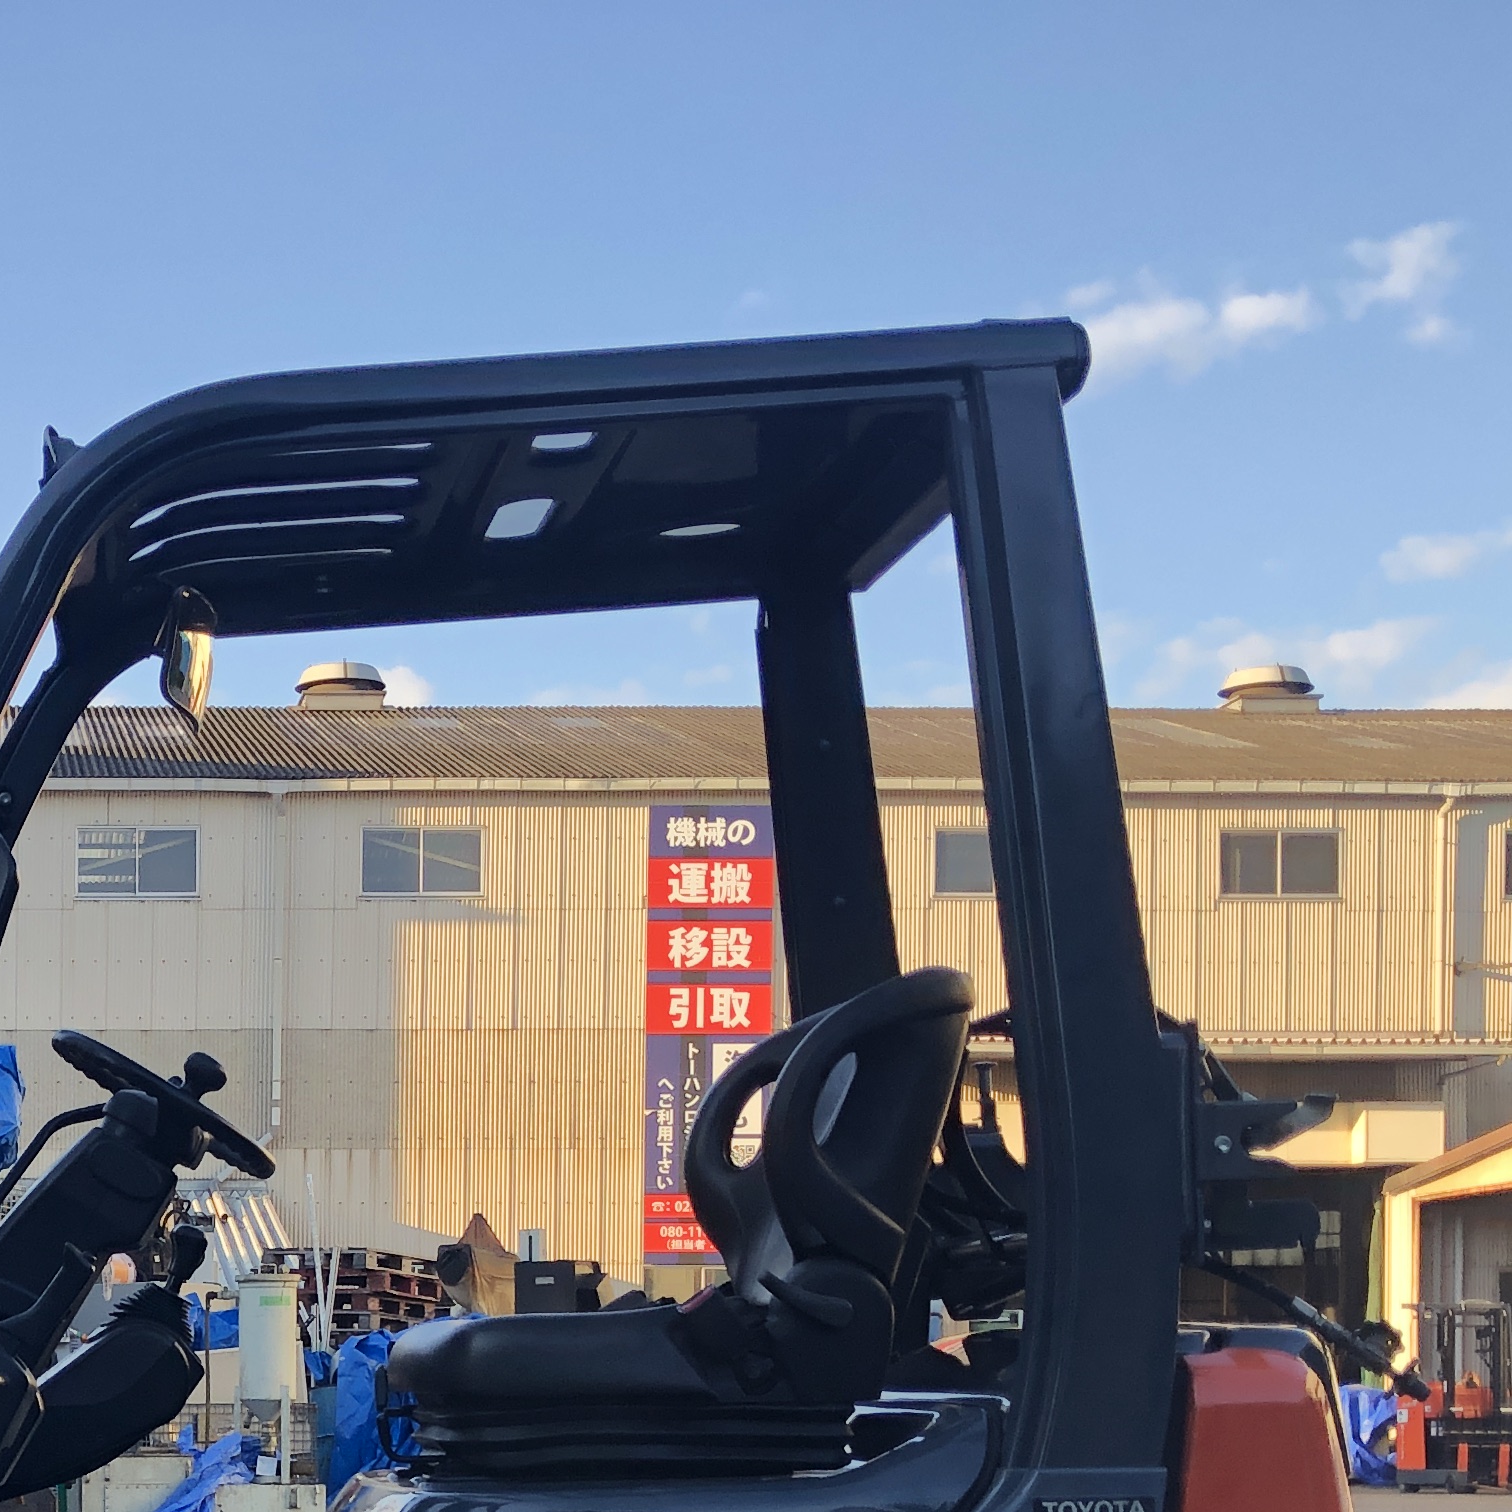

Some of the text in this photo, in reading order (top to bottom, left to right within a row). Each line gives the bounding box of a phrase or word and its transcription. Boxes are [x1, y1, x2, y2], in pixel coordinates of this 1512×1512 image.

[666, 816, 756, 848] 機械の
[667, 861, 753, 905] 運搬
[667, 926, 753, 969] 移設
[668, 987, 752, 1029] 引取
[656, 1077, 675, 1190] へご利用下さい
